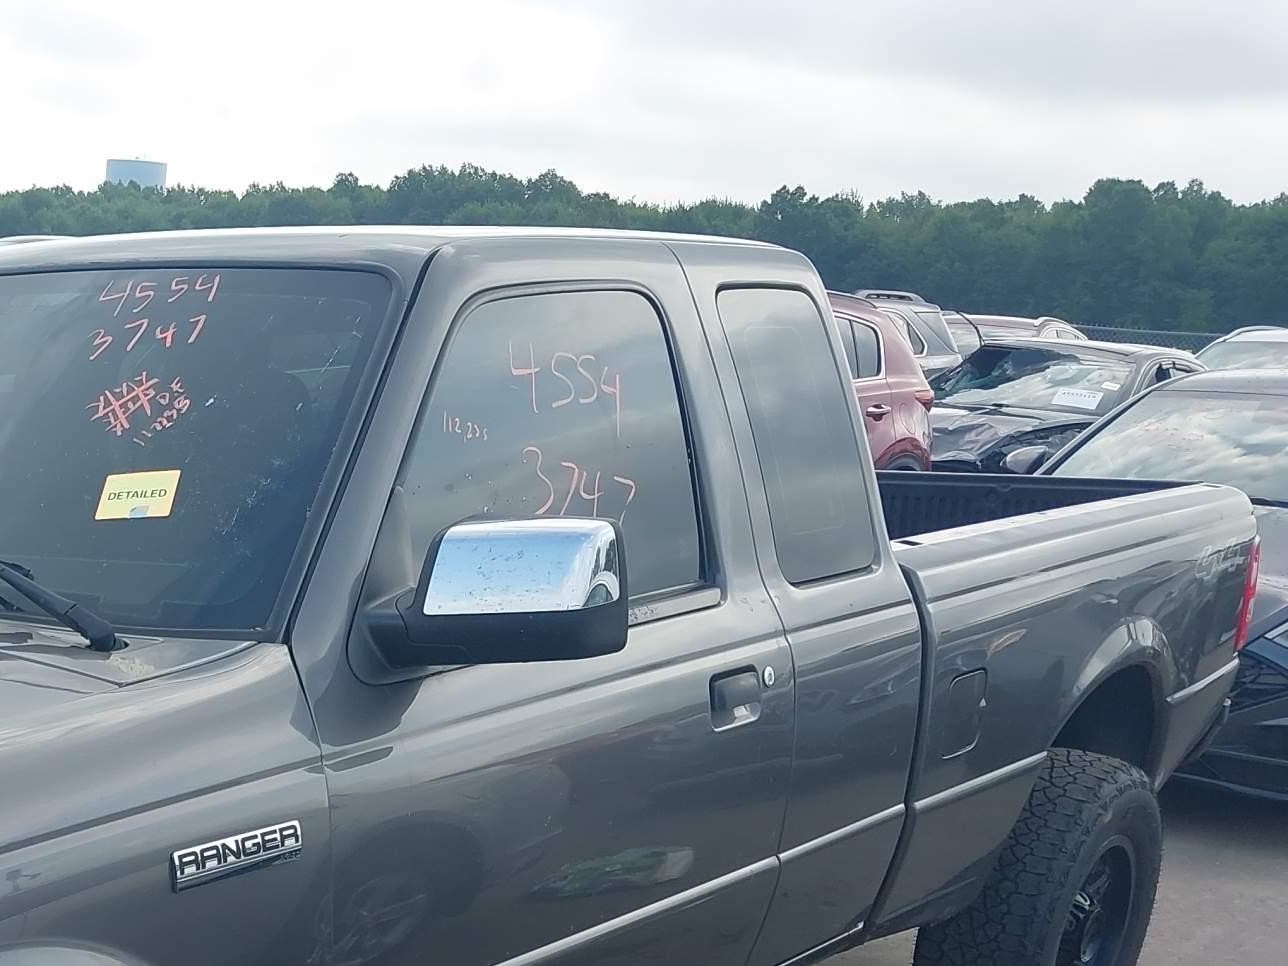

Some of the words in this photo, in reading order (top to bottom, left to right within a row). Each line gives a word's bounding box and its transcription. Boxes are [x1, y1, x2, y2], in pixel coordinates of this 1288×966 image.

[98, 274, 220, 317] 4554
[87, 315, 206, 361] 3747
[509, 343, 619, 438] 4554
[107, 488, 168, 501] DETAILED
[522, 446, 636, 526] 3747
[177, 824, 300, 876] RANGER
